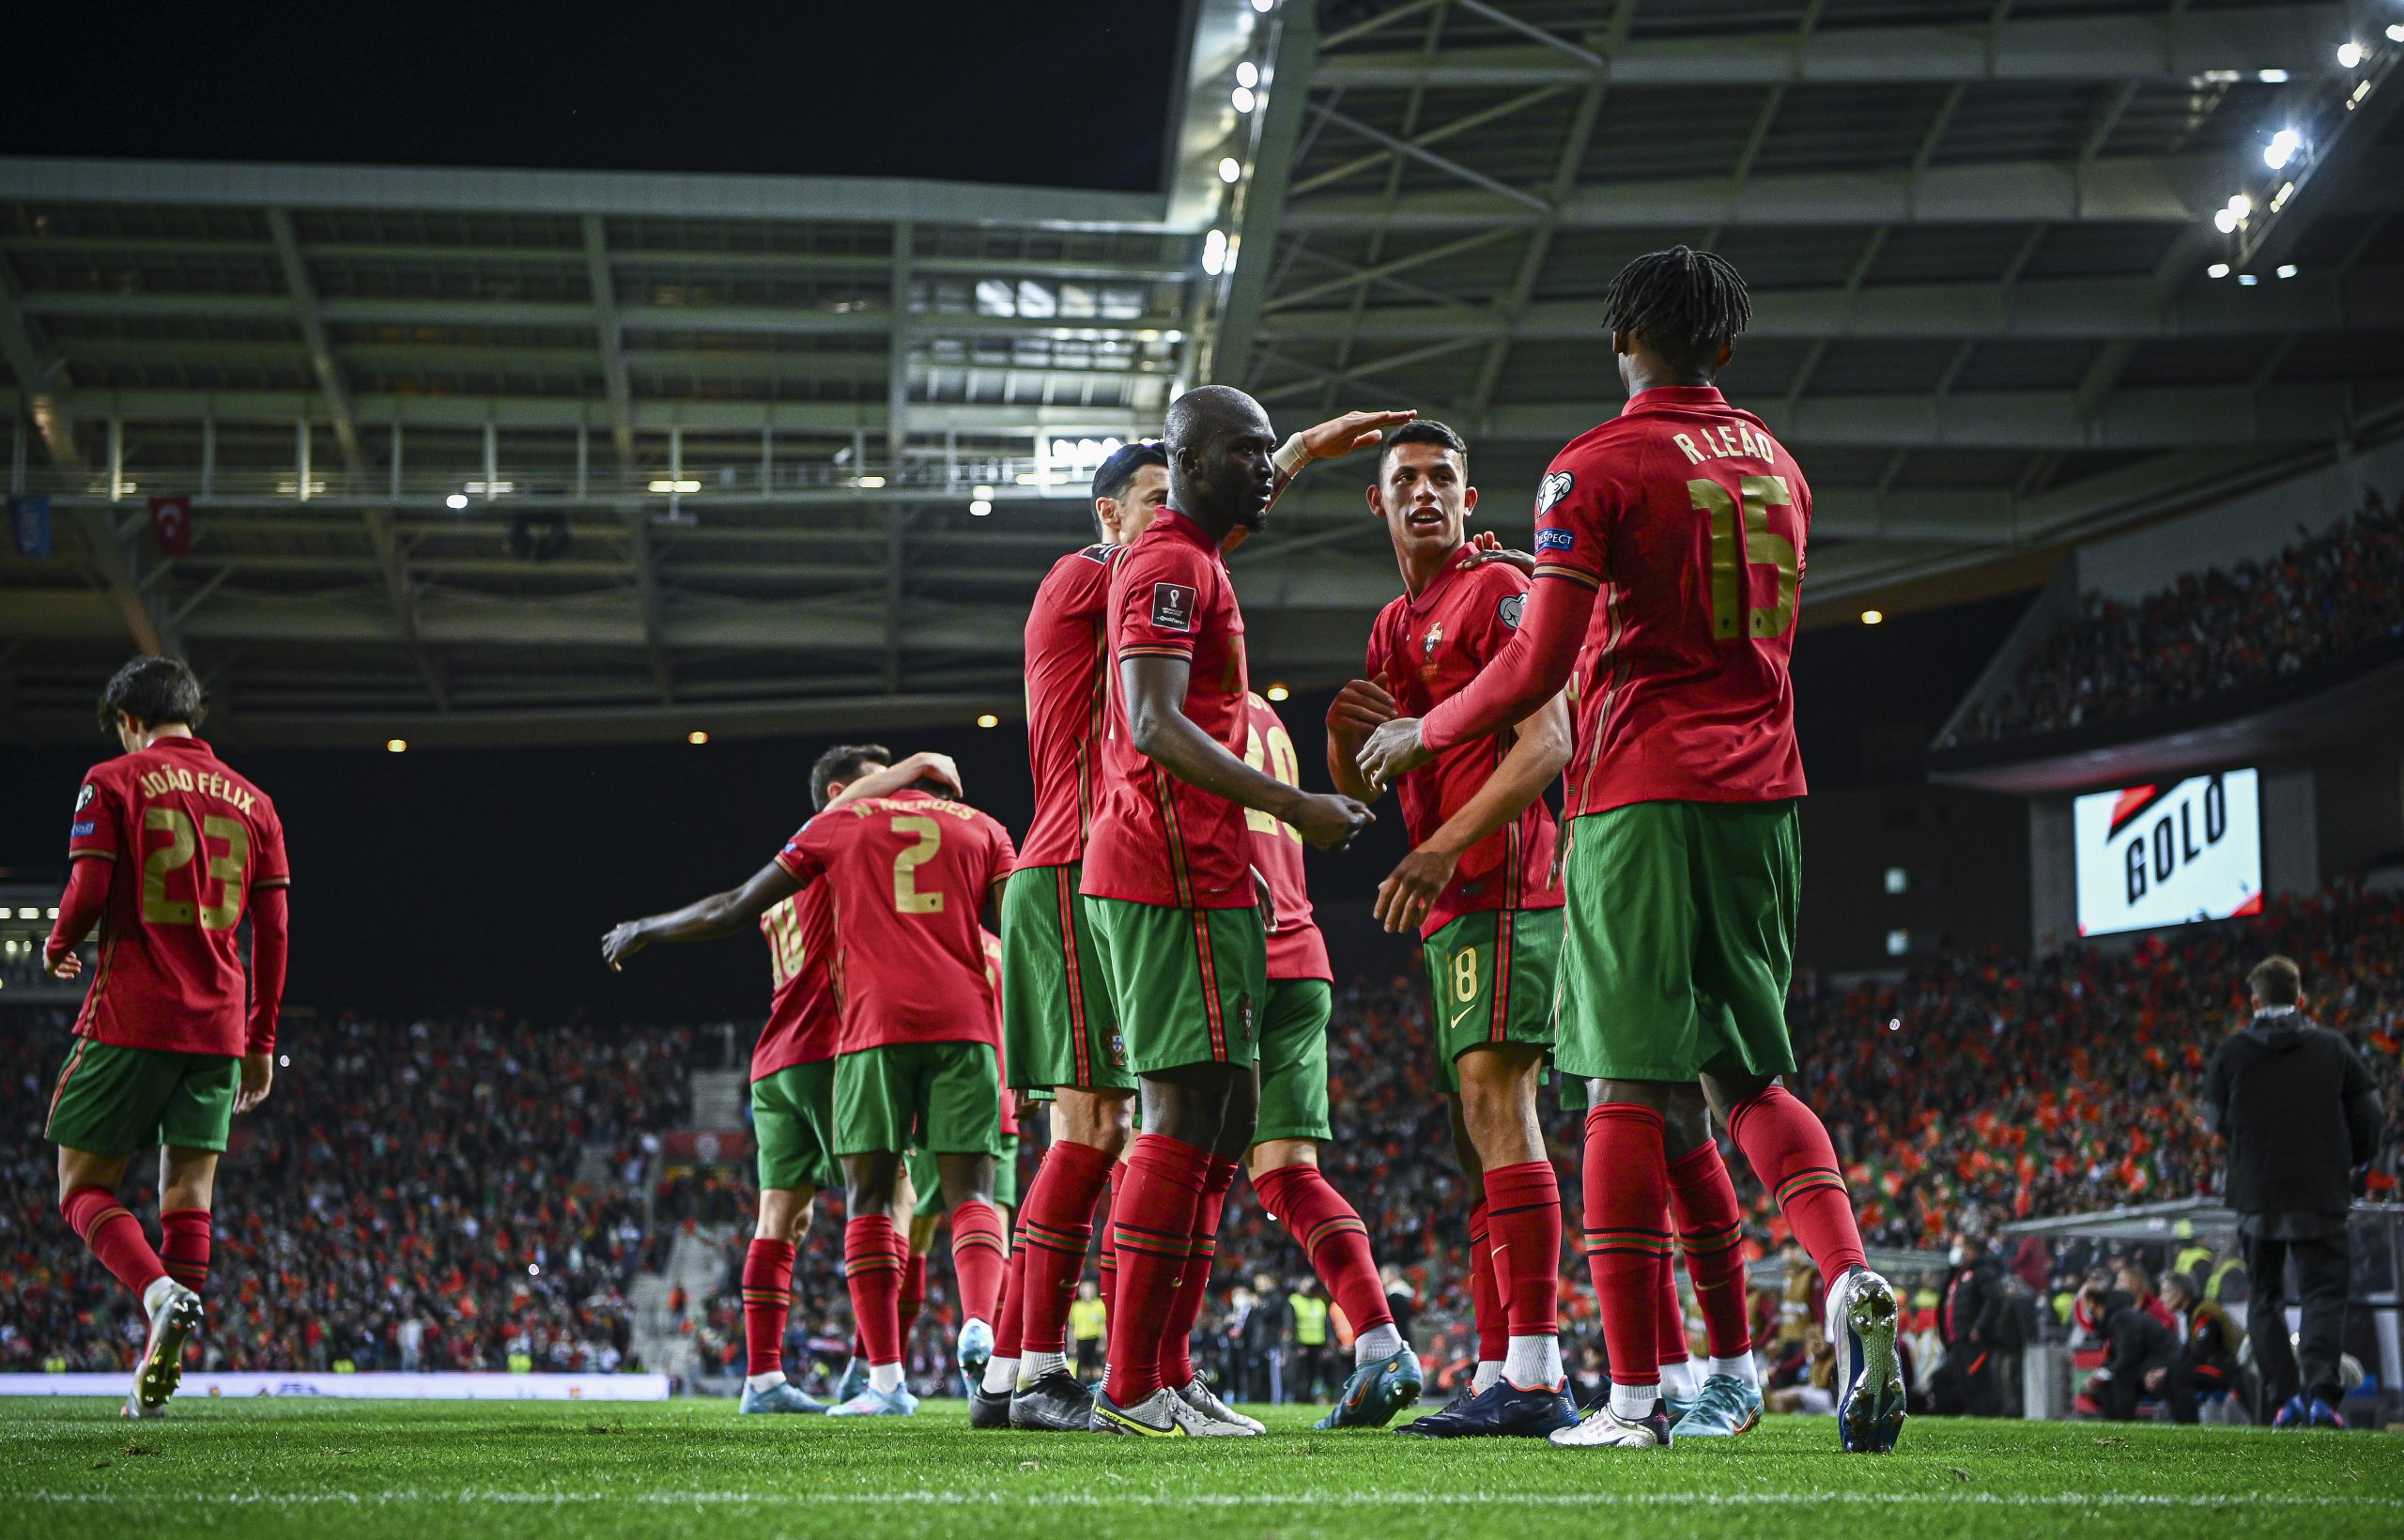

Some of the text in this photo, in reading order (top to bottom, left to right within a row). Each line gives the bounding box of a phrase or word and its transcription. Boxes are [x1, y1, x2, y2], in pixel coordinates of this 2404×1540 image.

[1687, 475, 1797, 639] 15
[140, 763, 256, 816] JOÃO FÉLIX
[2125, 776, 2226, 907] GOLO
[144, 808, 251, 929] 23
[890, 816, 943, 913] 2
[1446, 946, 1478, 1008] 18
